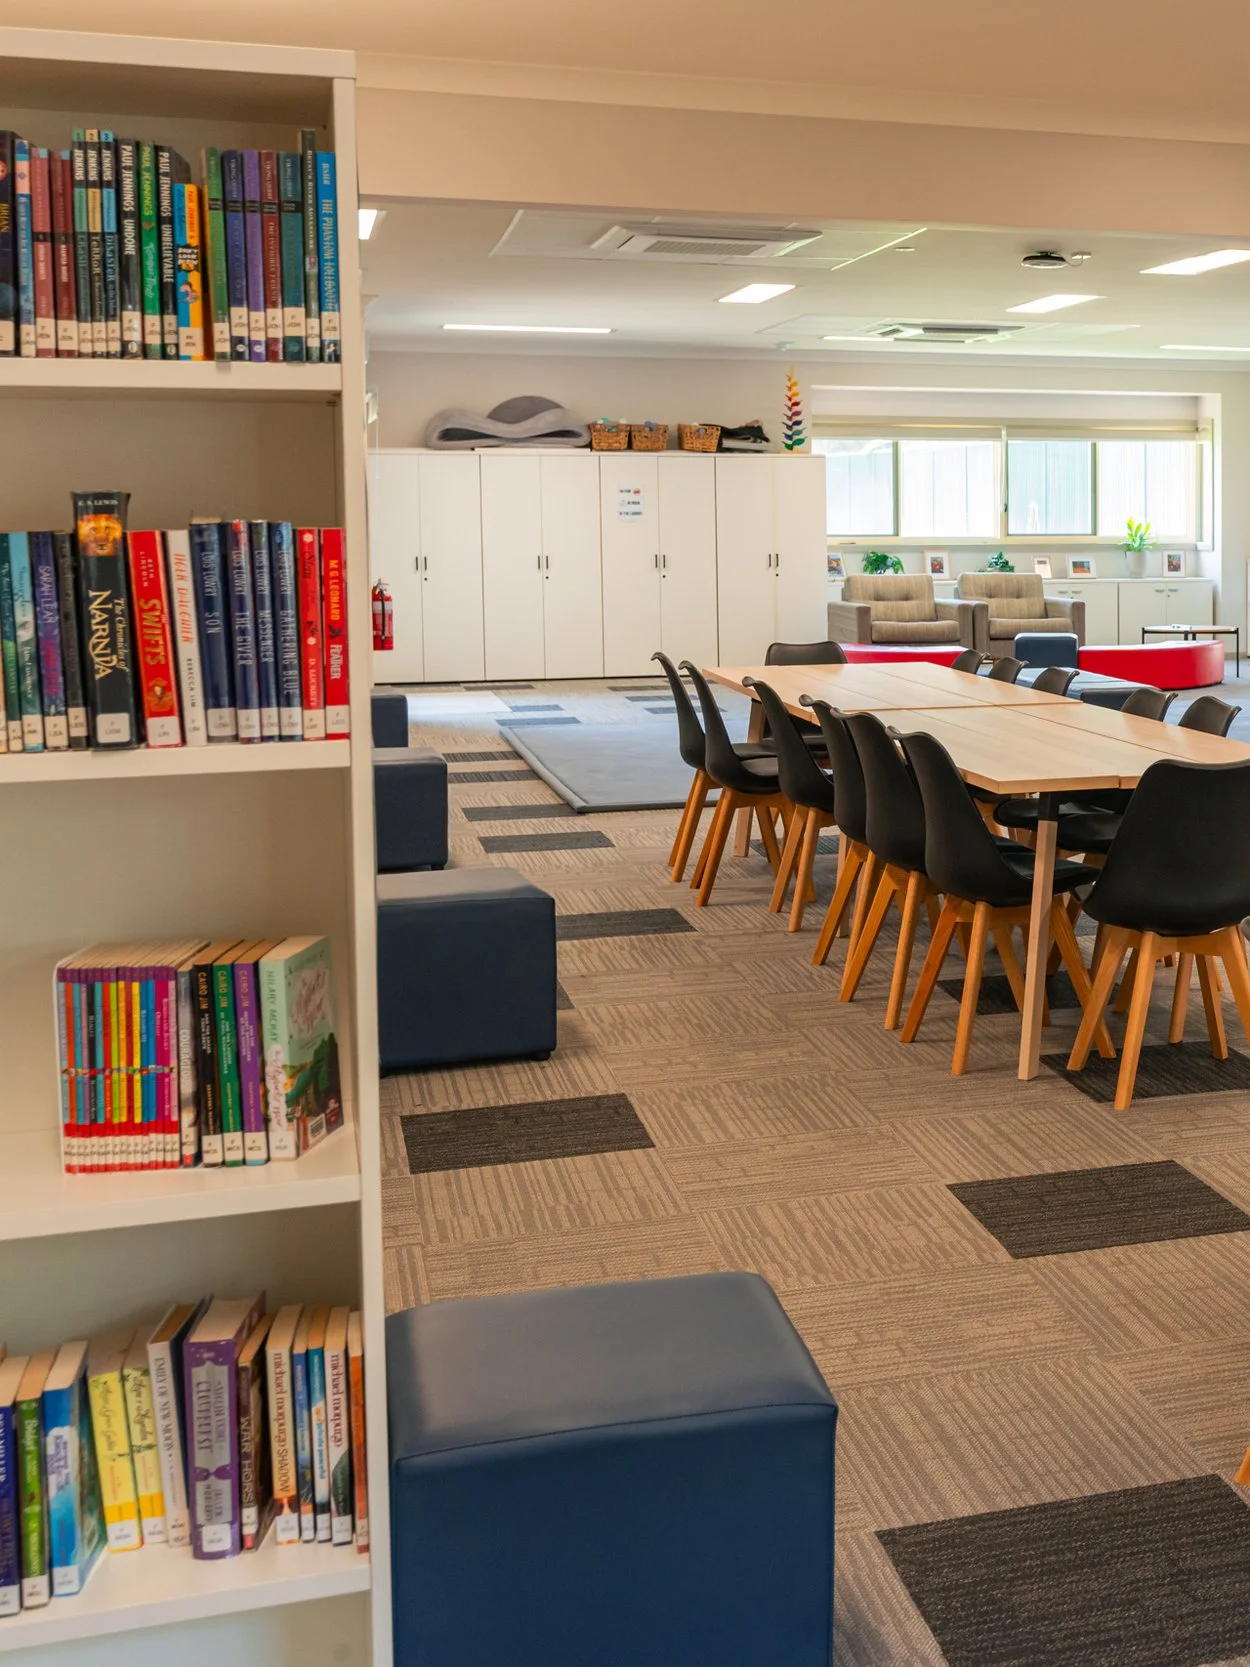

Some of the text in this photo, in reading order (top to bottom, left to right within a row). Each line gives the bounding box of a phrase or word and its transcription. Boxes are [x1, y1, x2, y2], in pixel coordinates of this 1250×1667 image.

[74, 149, 85, 181] JENKINS
[88, 149, 98, 181] JENKINS
[102, 149, 112, 181] JENKINS
[142, 146, 151, 169] PAUL
[122, 145, 136, 255] PAUL JENNINGS UNDONE
[143, 171, 154, 216] JENNINGS
[322, 199, 333, 214] THE
[0, 203, 8, 232] BRIAN
[159, 152, 174, 282] PAUL JENNINGS UNBELIEVABLE
[323, 217, 335, 259] PHANTOM
[39, 565, 54, 595] SARAH
[201, 551, 221, 634] LOIS LOWRY SON
[329, 579, 340, 621] LEONARD
[41, 596, 57, 624] LEAN
[177, 587, 193, 644] DAUGHTER
[232, 551, 252, 666] LOIS LOWRY THE GIVER
[255, 550, 273, 663] LOIS LOWRY MESSENGER
[278, 550, 298, 695] LOIS LOWRY GATHERING BLUE
[88, 589, 115, 680] NARNIA
[114, 599, 130, 673] The Chronicles of
[140, 598, 166, 665] SWIFTS
[186, 658, 197, 708] REBECCA LIM
[330, 644, 342, 680] FEATHER
[198, 972, 208, 1010] CAIRO JIM
[218, 970, 228, 1008] CAIRO JIM
[239, 970, 249, 1007] CAIRO JIM
[266, 970, 277, 1005] HILARY
[154, 1357, 172, 1450] EMILY OF NEW MOON
[331, 1354, 345, 1447] michael morpurgo
[24, 1420, 39, 1450] Bridget
[241, 1416, 250, 1453] WAR
[274, 1353, 290, 1492] michael morpurgo SHADOW
[317, 1449, 327, 1479] peaceful
